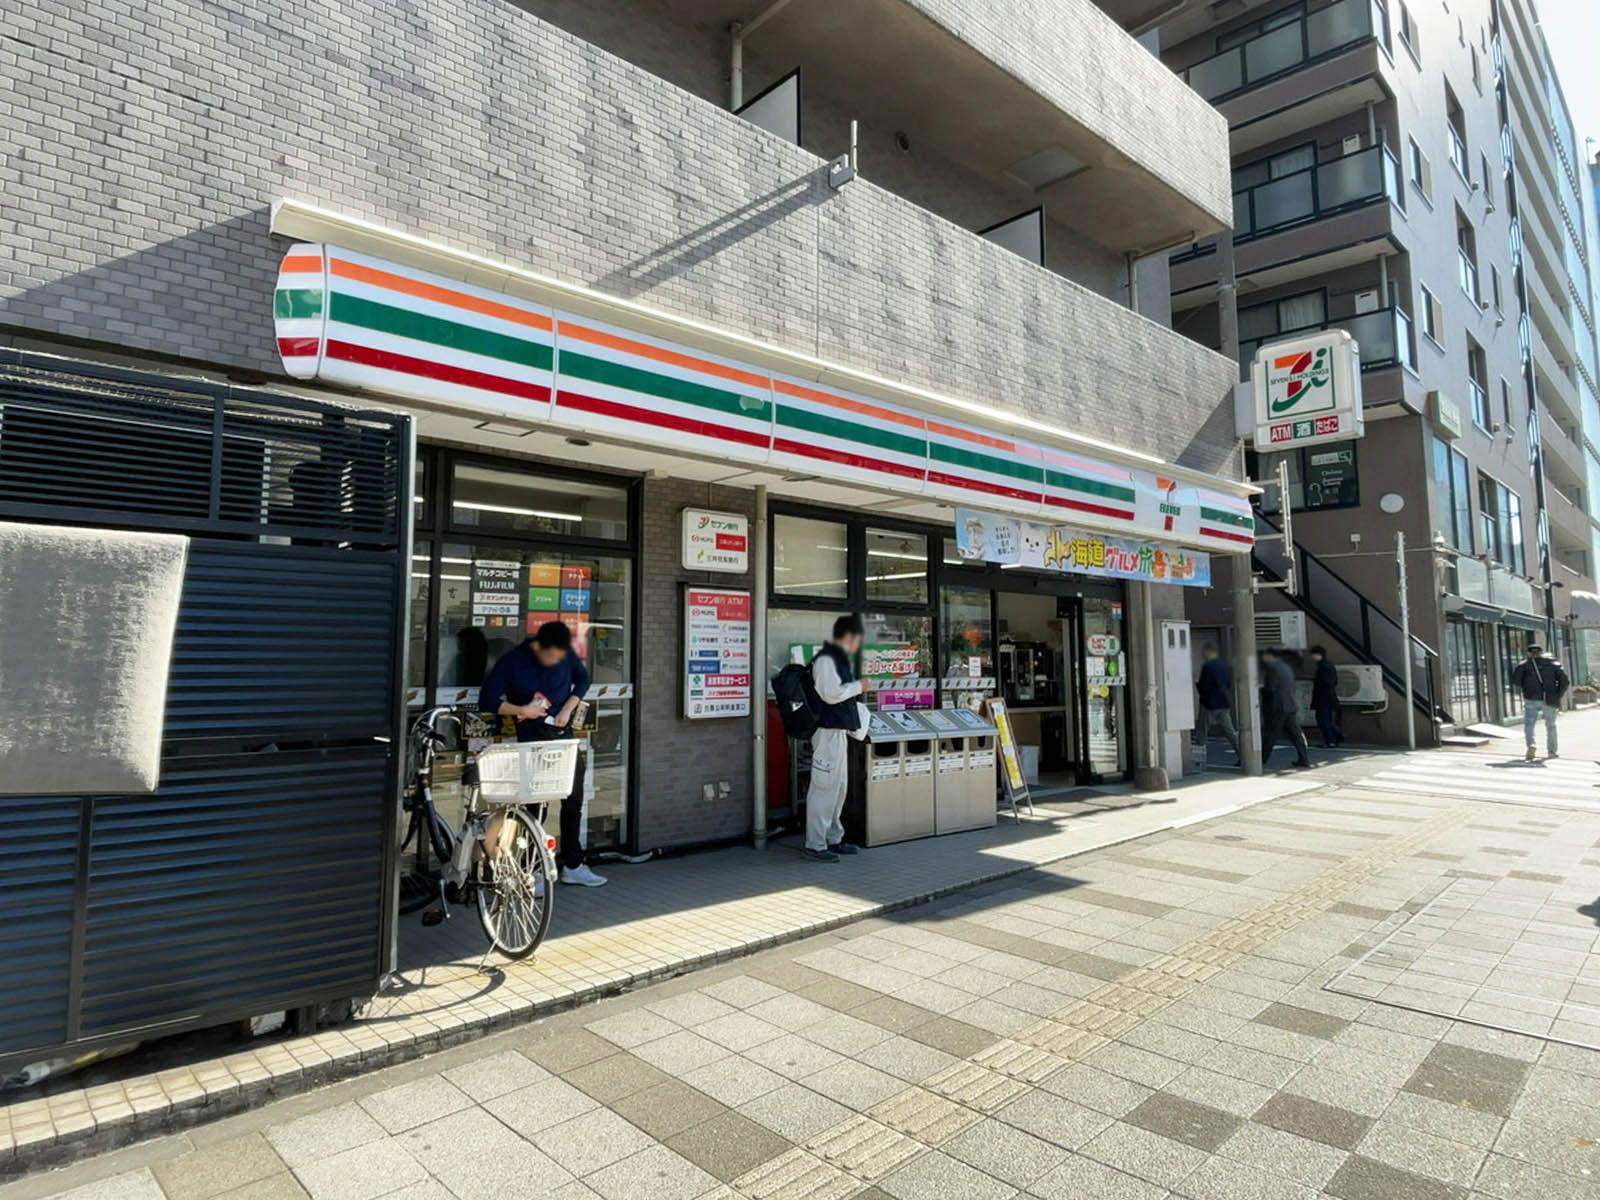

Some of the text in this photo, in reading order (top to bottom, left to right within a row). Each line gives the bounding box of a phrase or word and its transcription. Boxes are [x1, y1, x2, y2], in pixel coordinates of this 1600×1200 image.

[1271, 425, 1291, 441] ATM
[1295, 422, 1312, 437] 酒
[1316, 418, 1338, 433] たばこ
[479, 581, 515, 590] FUJIFILM
[727, 597, 744, 605] ATM
